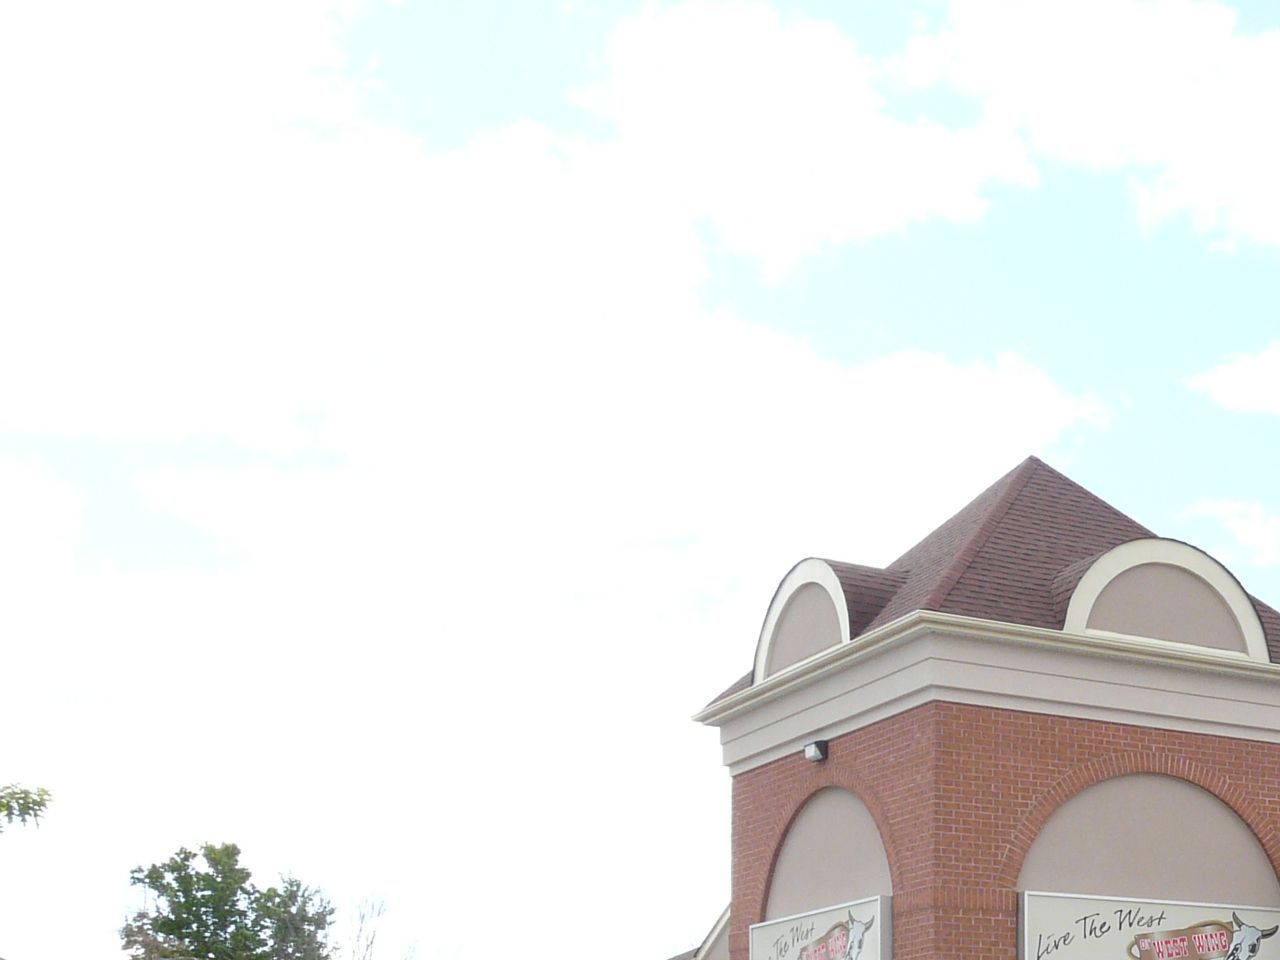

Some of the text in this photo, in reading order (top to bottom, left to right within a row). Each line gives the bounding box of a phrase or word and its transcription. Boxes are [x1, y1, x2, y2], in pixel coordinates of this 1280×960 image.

[1075, 913, 1111, 939] The
[1114, 907, 1166, 931] West
[773, 934, 790, 960] The
[789, 921, 815, 947] West
[1152, 936, 1189, 959] WEST
[1192, 930, 1229, 954] WING
